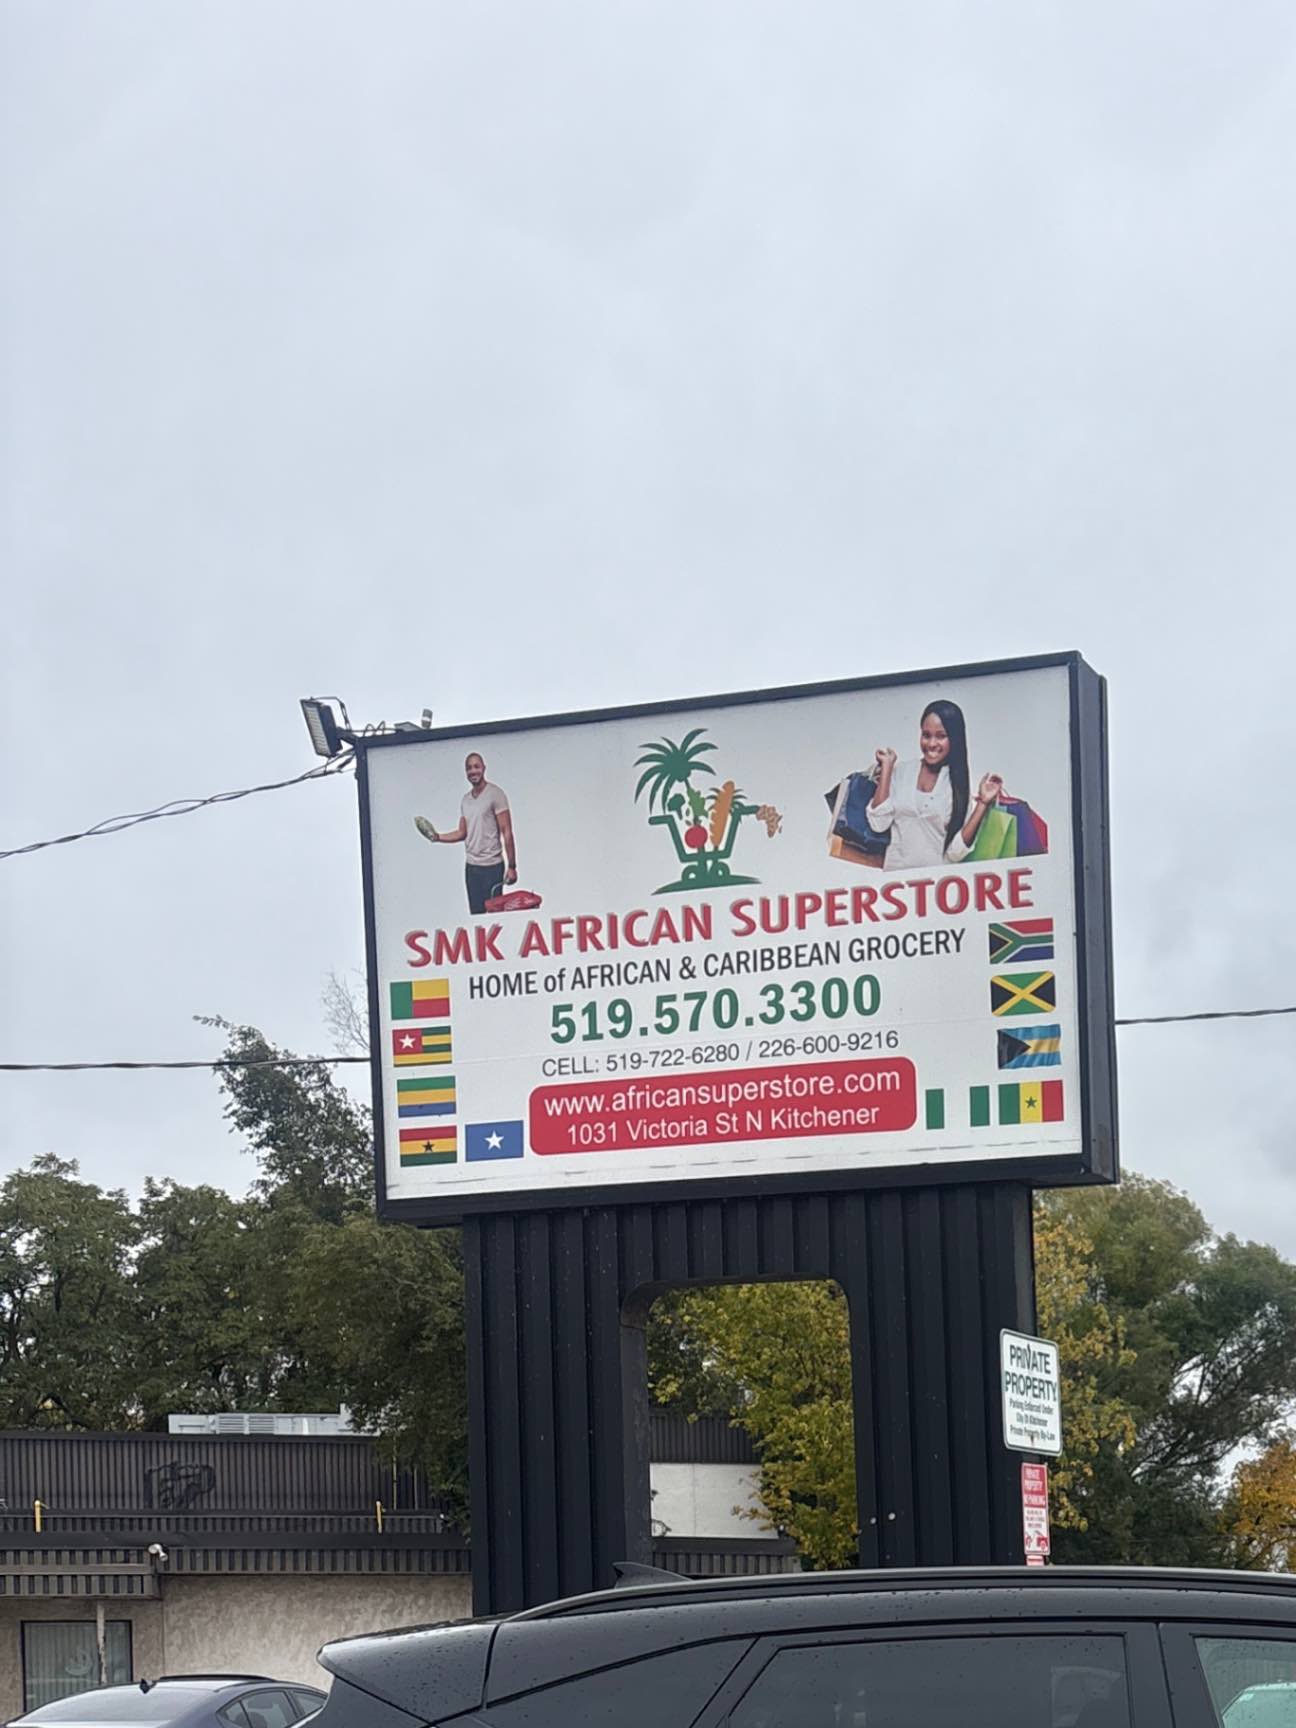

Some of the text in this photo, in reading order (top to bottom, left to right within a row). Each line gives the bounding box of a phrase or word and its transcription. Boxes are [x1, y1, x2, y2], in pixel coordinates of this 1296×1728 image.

[404, 867, 1035, 968] SMK AFRICAN SUPERSTORE
[468, 927, 966, 1000] HOME of AFRICAN & CARIBBEAN GROCERY
[550, 973, 882, 1044] 519.570.3300
[541, 1056, 600, 1078] CELL:
[605, 1042, 741, 1073] 519-722-6280
[758, 1029, 900, 1059] 226-600-9216
[544, 1069, 901, 1117] www.africansuperstore.com
[567, 1103, 880, 1146] 1031 Victoria St N Kitchener
[1009, 1343, 1051, 1374] PRIVATE
[1005, 1370, 1057, 1402] PROPERTY
